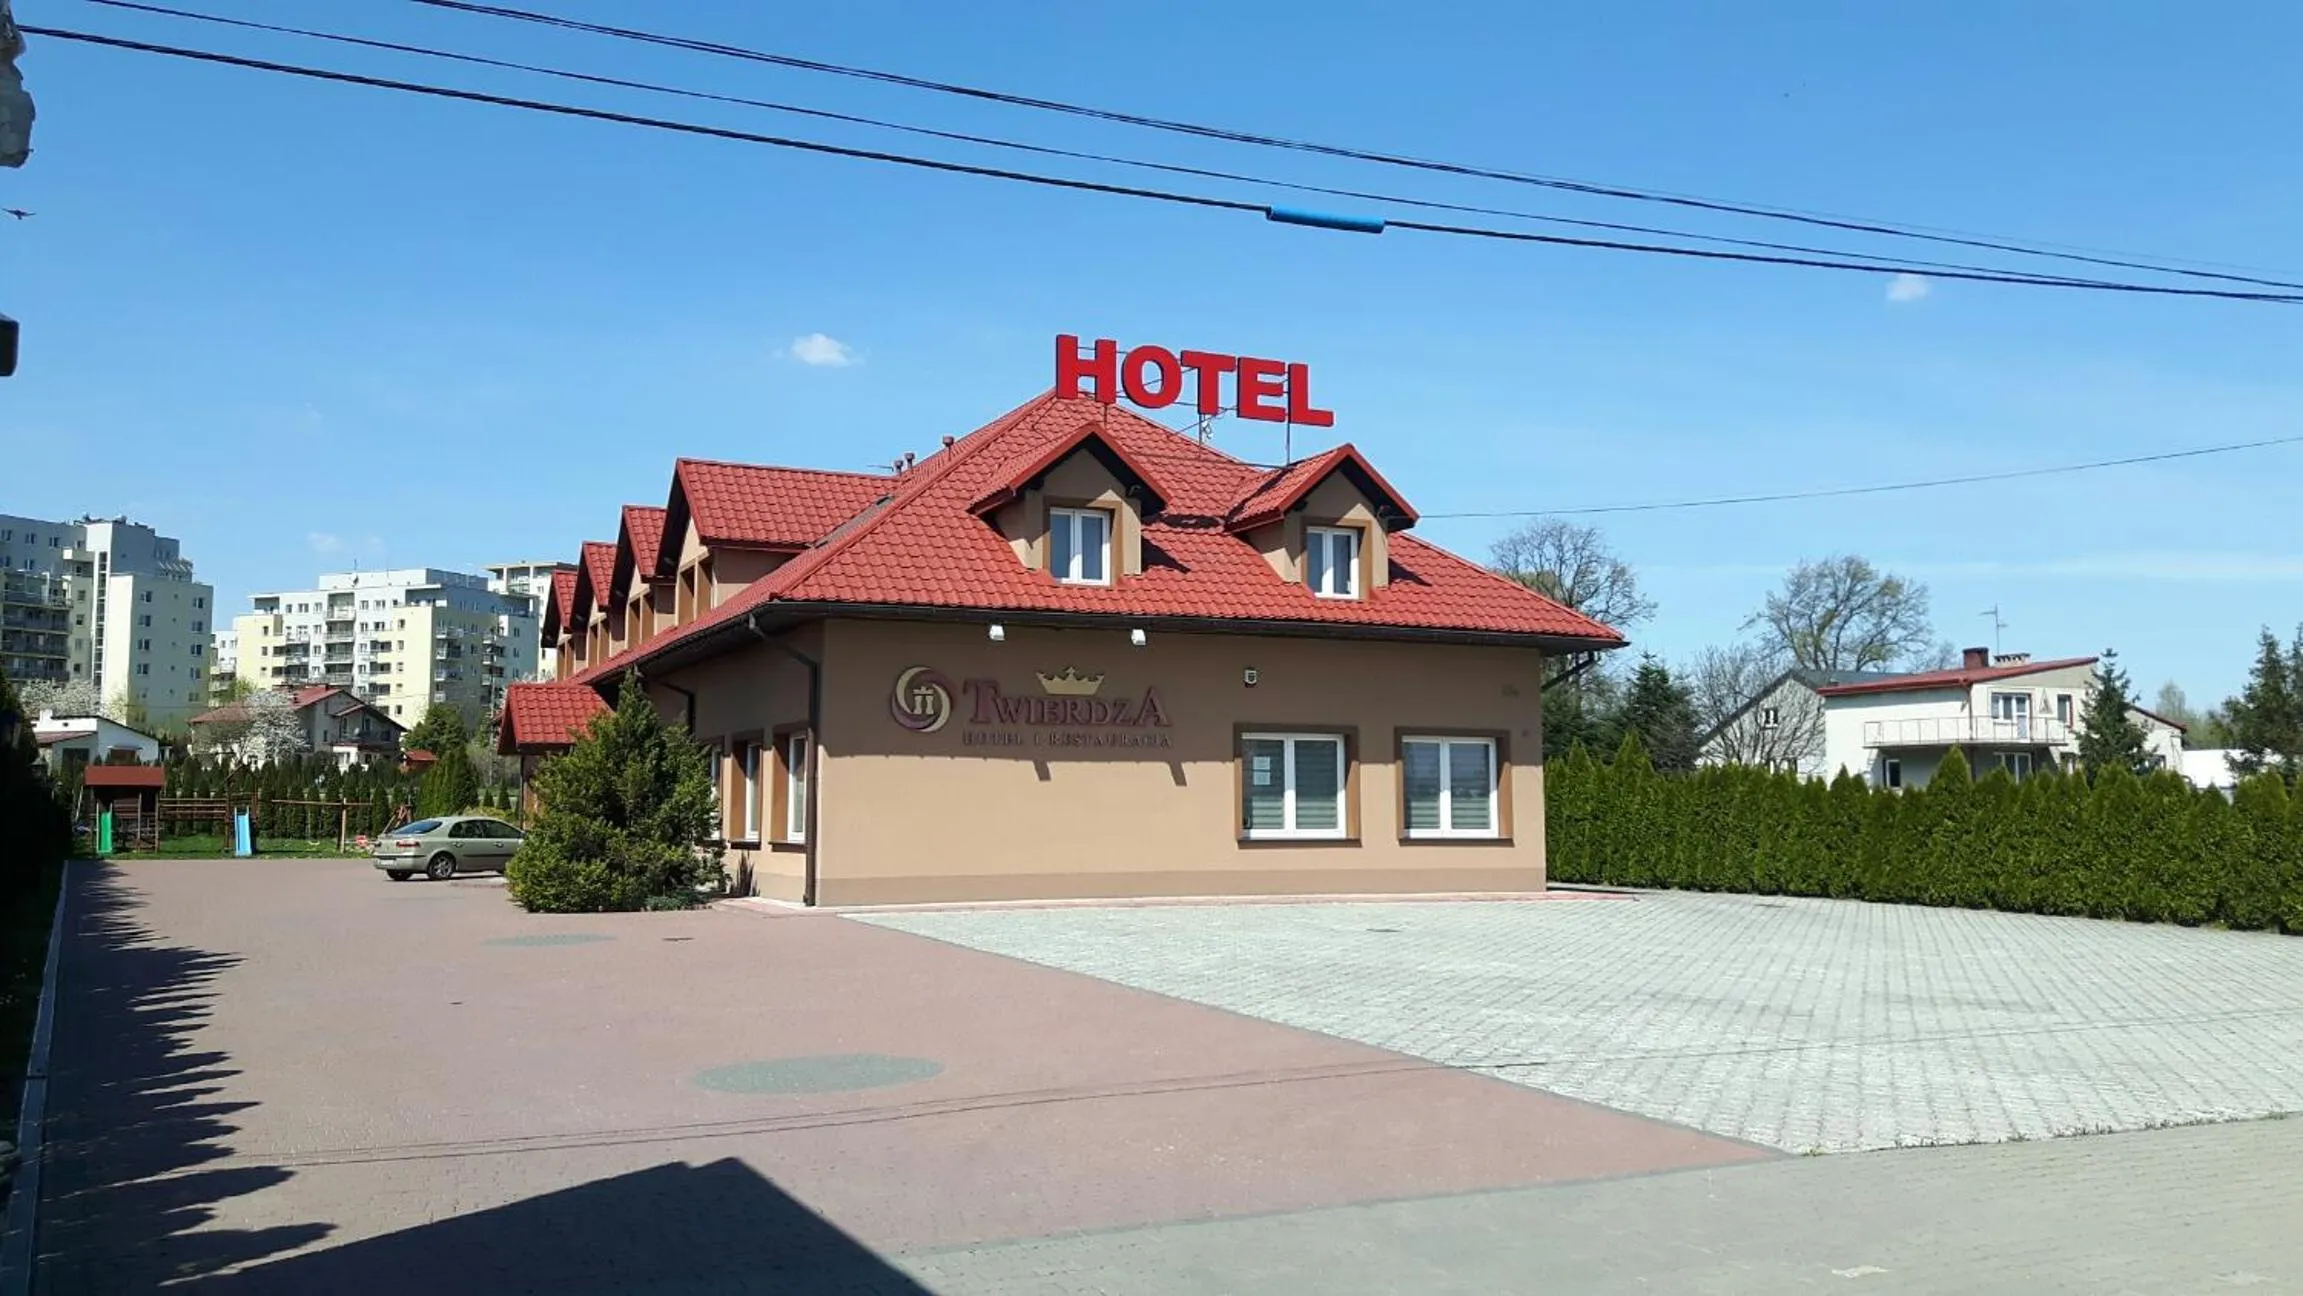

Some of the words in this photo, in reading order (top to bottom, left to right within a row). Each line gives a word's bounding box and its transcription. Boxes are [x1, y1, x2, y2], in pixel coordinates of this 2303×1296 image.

[1055, 334, 1334, 428] HOTEL
[962, 677, 1174, 728] TWIERDZA
[962, 730, 1023, 746] HOTEL
